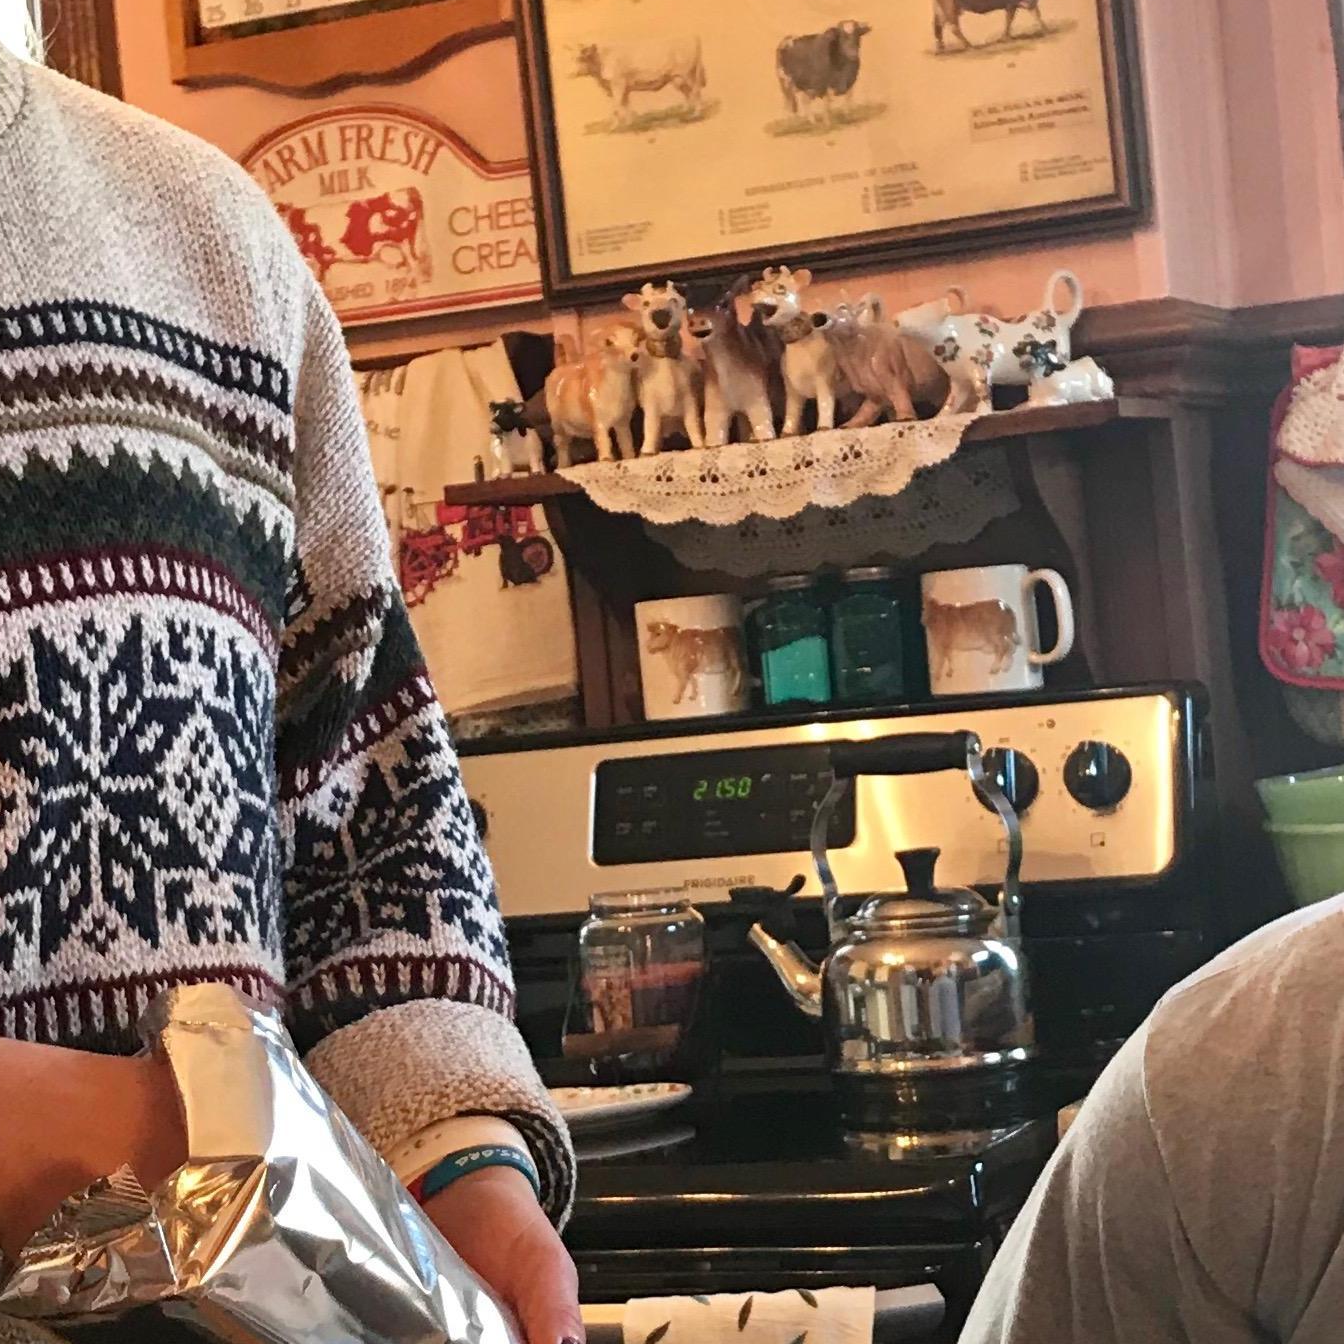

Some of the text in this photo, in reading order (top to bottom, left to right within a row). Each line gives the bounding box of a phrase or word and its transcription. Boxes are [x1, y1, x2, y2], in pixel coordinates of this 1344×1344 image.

[207, 4, 227, 23] 25
[257, 124, 448, 194] ARM FRESH
[319, 166, 376, 197] MILK
[452, 238, 538, 275] CREA
[683, 873, 756, 889] FRIGIDAIRE
